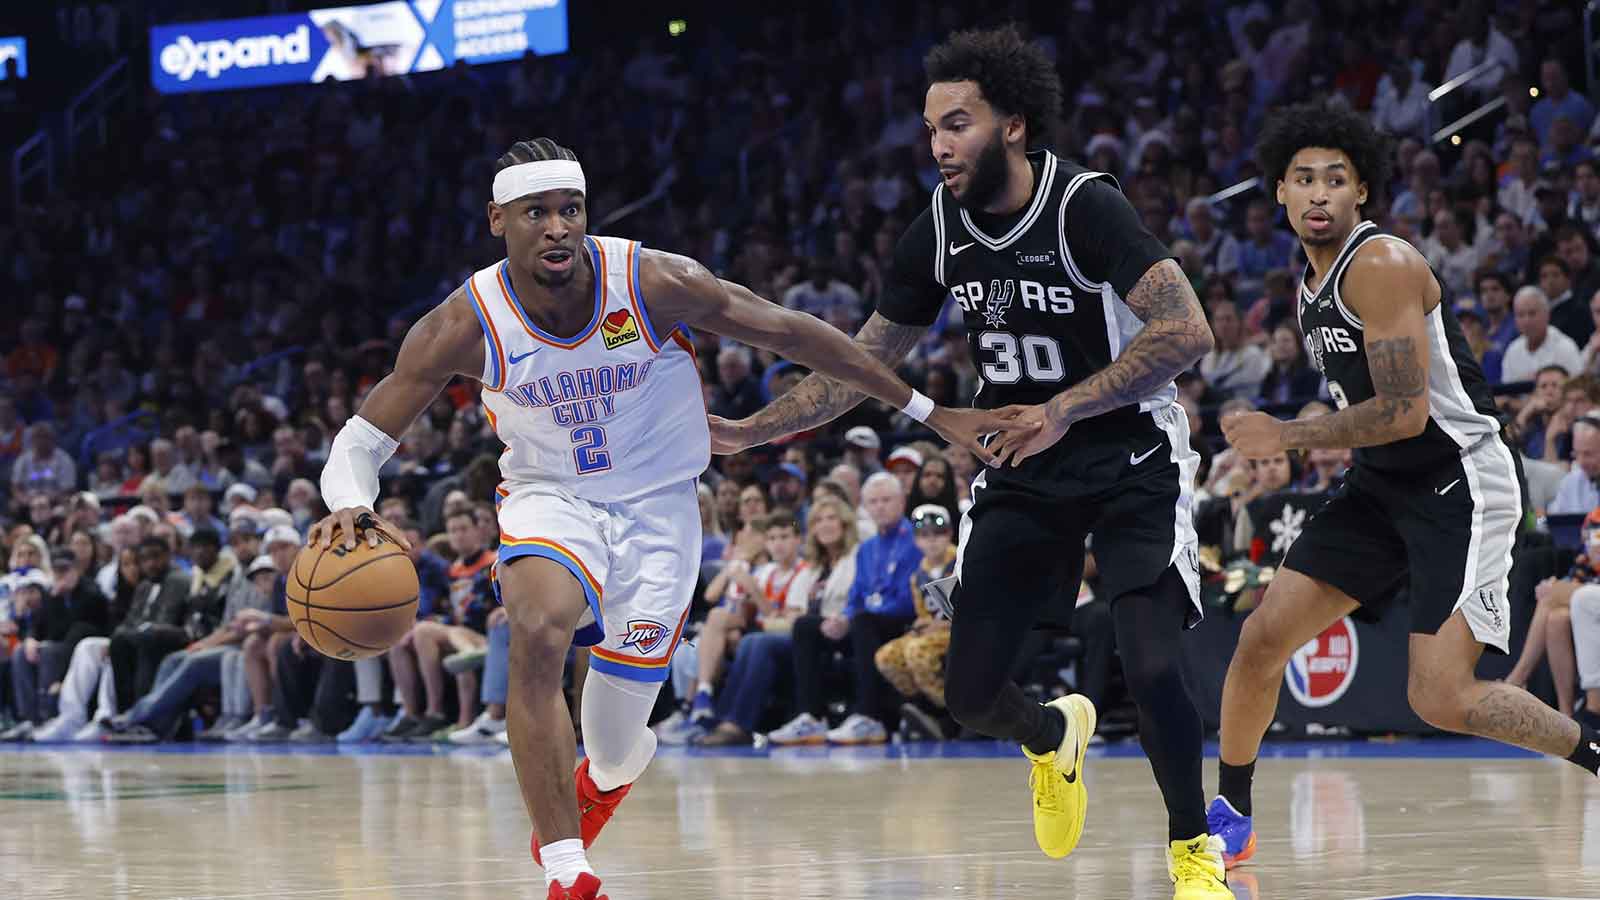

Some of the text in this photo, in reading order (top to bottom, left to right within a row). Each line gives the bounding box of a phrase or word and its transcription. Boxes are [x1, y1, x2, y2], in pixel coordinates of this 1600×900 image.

[160, 24, 310, 81] expand
[1020, 255, 1050, 263] LEDGER
[978, 330, 1066, 384] 30
[504, 359, 654, 408] OKLAHOMA
[553, 396, 616, 424] CITY
[570, 424, 613, 475] 2
[623, 628, 660, 645] OKC
